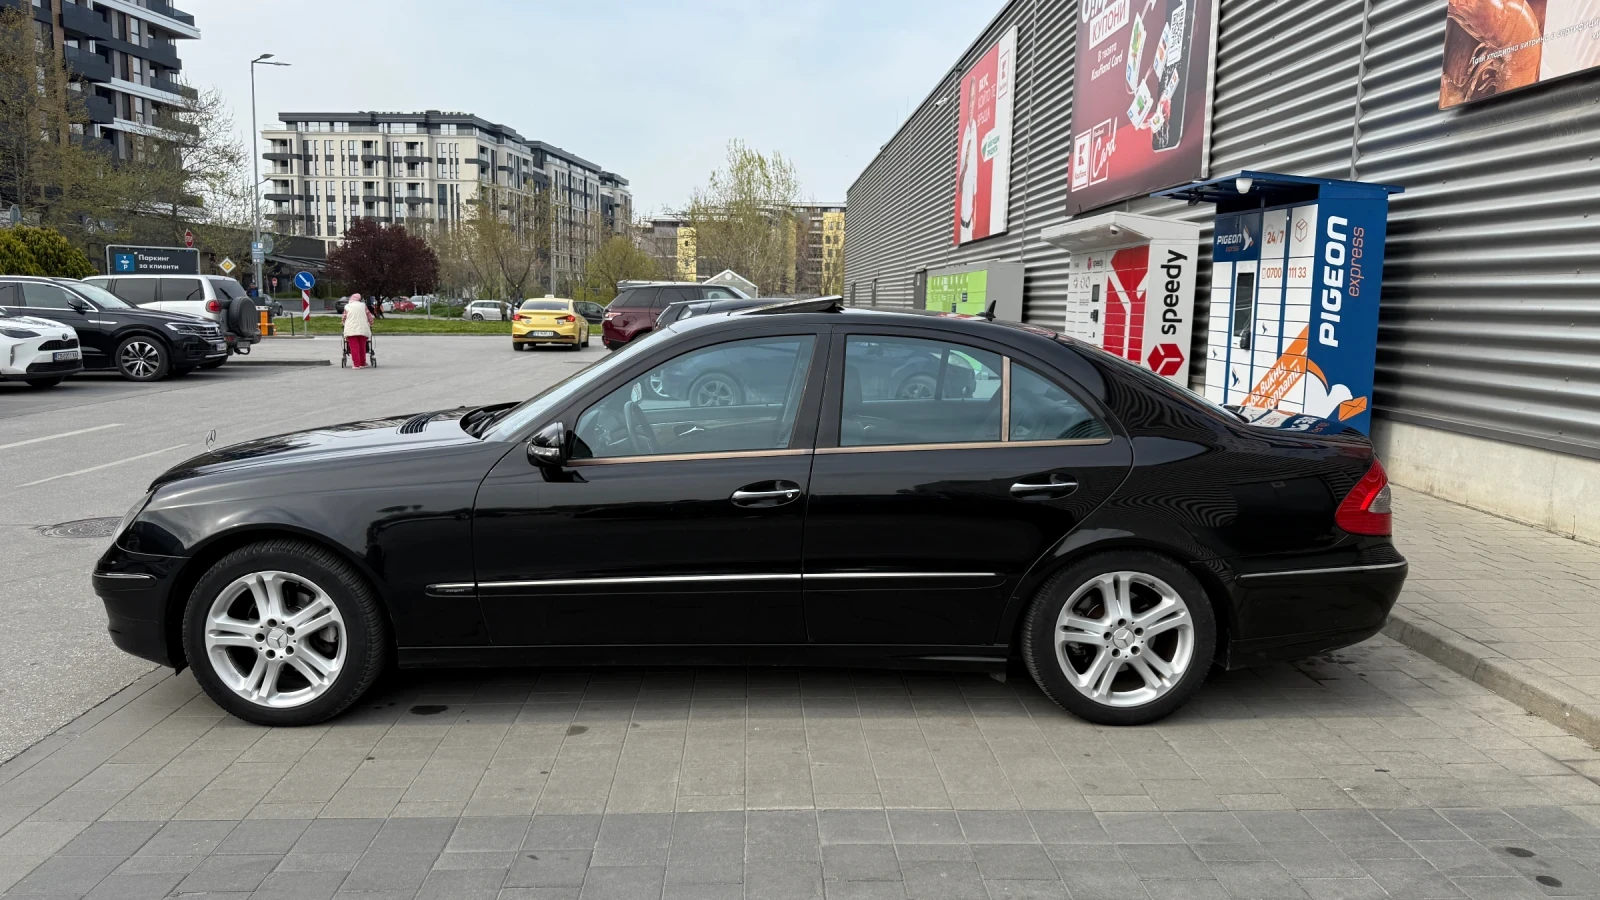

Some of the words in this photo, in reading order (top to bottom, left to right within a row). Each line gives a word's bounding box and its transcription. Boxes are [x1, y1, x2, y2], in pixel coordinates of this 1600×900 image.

[1092, 1, 1126, 43] КУПОНИ
[1091, 57, 1112, 81] Kaufland
[1111, 49, 1124, 68] Card
[1097, 50, 1102, 63] В
[1092, 116, 1117, 178] Card
[1216, 234, 1242, 245] PIGEON
[1266, 230, 1284, 245] 24/7
[1266, 267, 1282, 278] 0700
[1288, 267, 1296, 278] 111
[1298, 266, 1306, 278] 33
[1348, 226, 1365, 297] express
[1160, 249, 1188, 335] speedy
[1319, 215, 1348, 348] PIGEON
